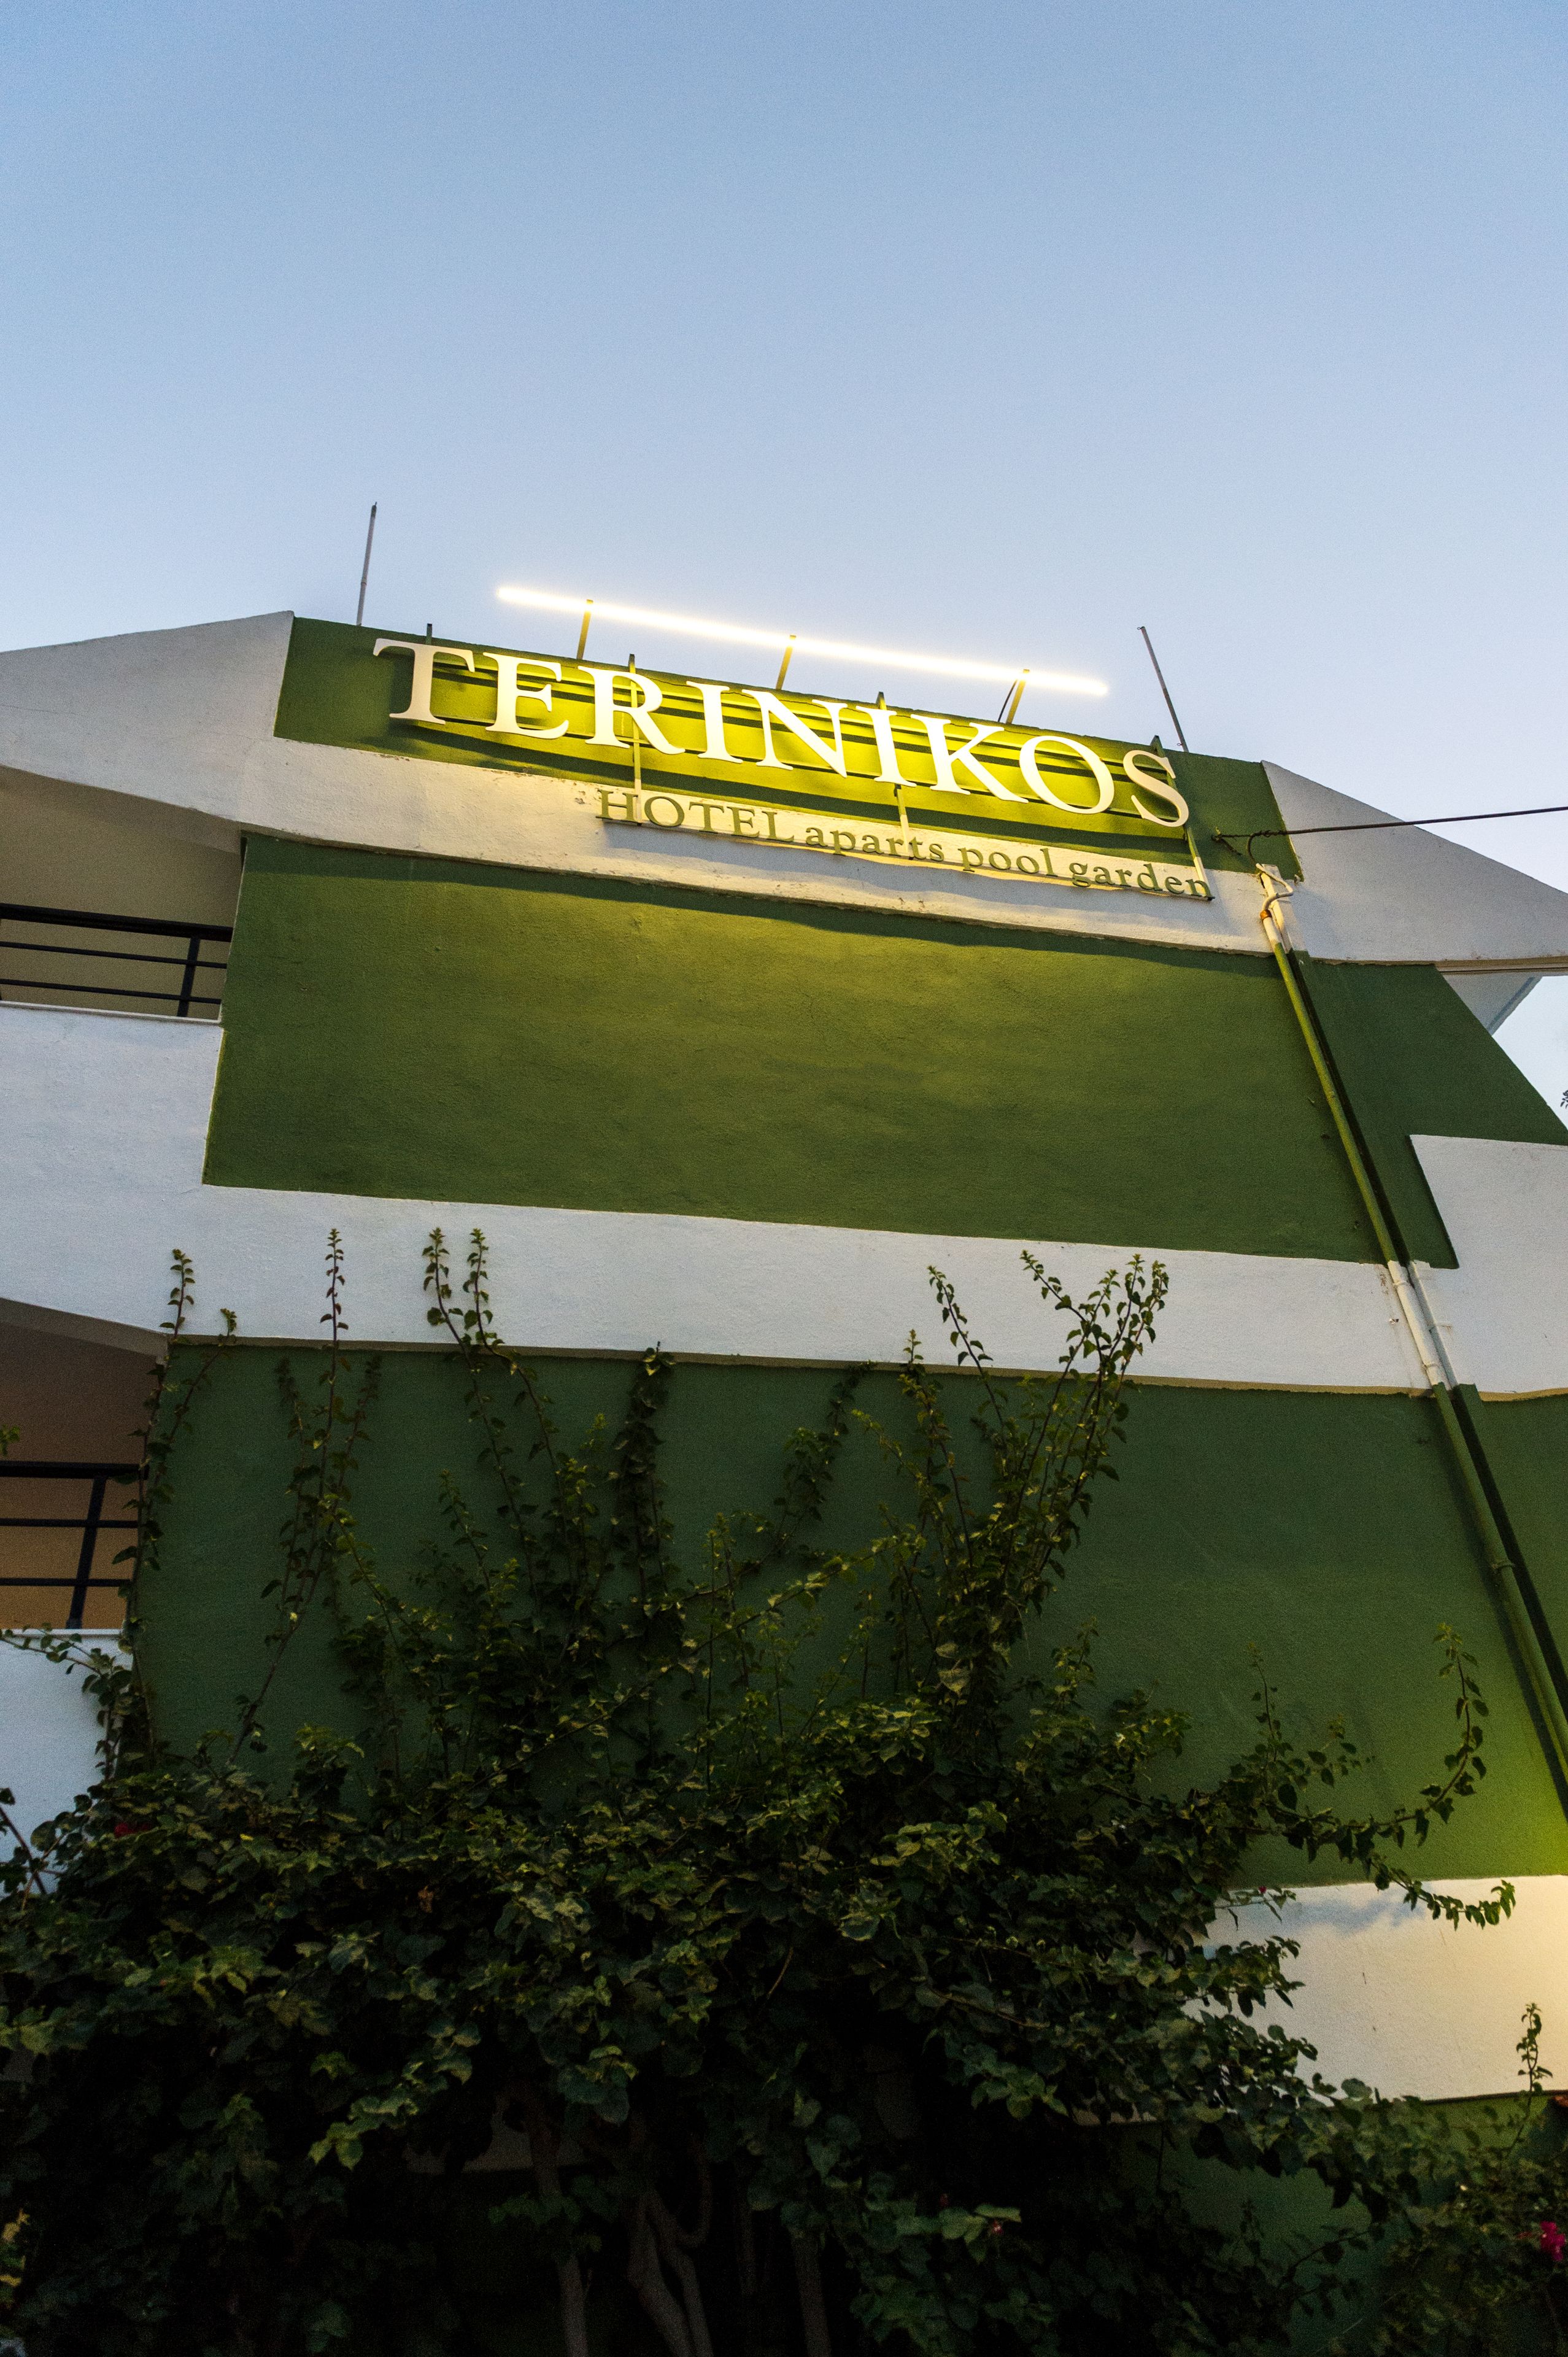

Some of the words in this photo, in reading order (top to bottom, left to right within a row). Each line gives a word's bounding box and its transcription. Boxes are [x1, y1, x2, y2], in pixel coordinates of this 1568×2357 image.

[373, 638, 1189, 827] TERINIKOS
[595, 789, 795, 843] HOTEL
[805, 826, 944, 862] aparts
[957, 847, 1059, 877] pool
[1068, 863, 1213, 899] garden
